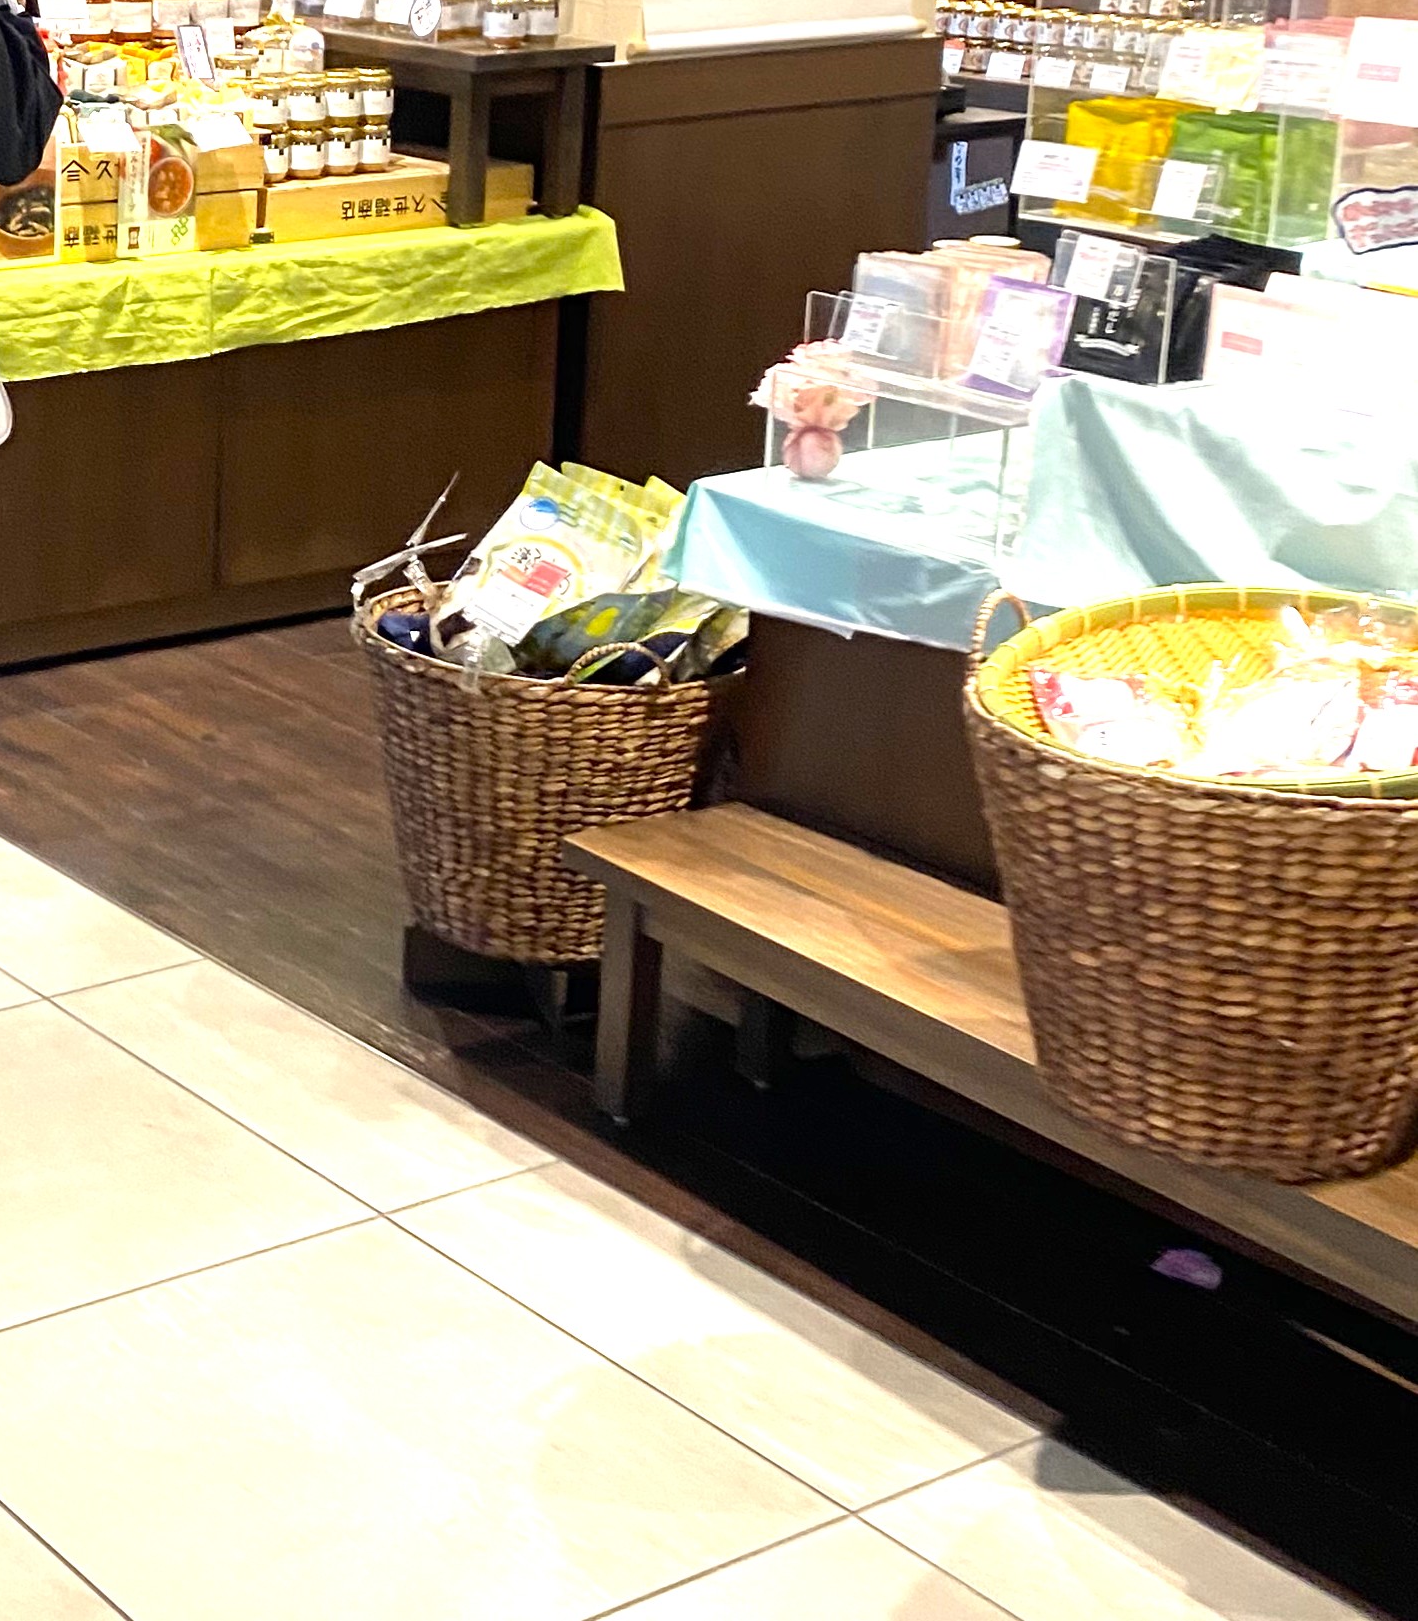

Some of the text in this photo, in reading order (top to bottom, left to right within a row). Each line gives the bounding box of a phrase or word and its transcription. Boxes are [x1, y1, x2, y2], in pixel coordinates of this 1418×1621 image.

[341, 193, 427, 220] 久世福商店
